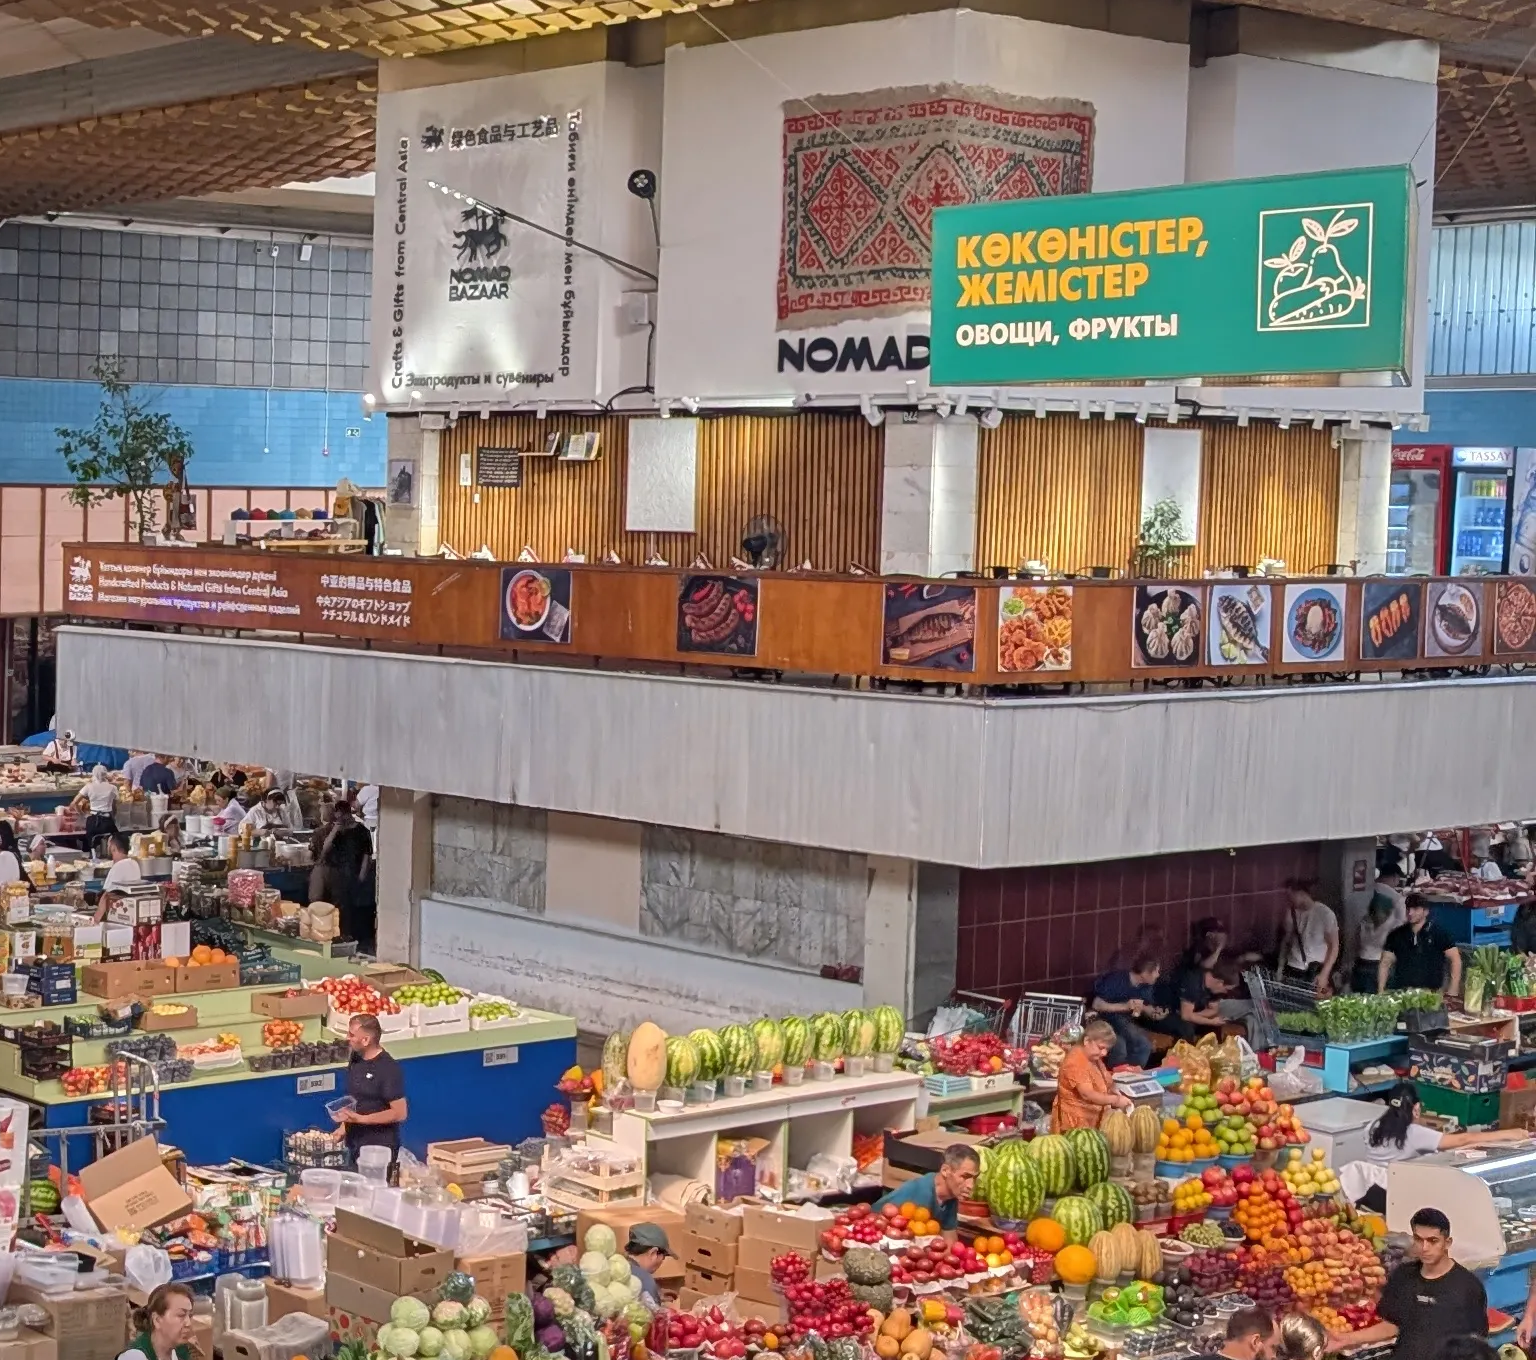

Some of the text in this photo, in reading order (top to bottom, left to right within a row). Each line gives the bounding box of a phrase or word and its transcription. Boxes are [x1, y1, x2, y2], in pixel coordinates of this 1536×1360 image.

[957, 217, 1208, 268] КӨКӨНІСТЕР,
[391, 137, 410, 389] Crafts & Gifts from Central Asia
[449, 265, 511, 283] NOMAD
[449, 283, 509, 301] BAZAAR
[956, 263, 1149, 307] ЖЕМІСТЕР
[956, 314, 1178, 346] ОВОЩИ, ФРУКТЫ
[778, 335, 930, 373] NOMAD
[495, 372, 554, 386] сувениры
[1470, 451, 1512, 462] TASSAY
